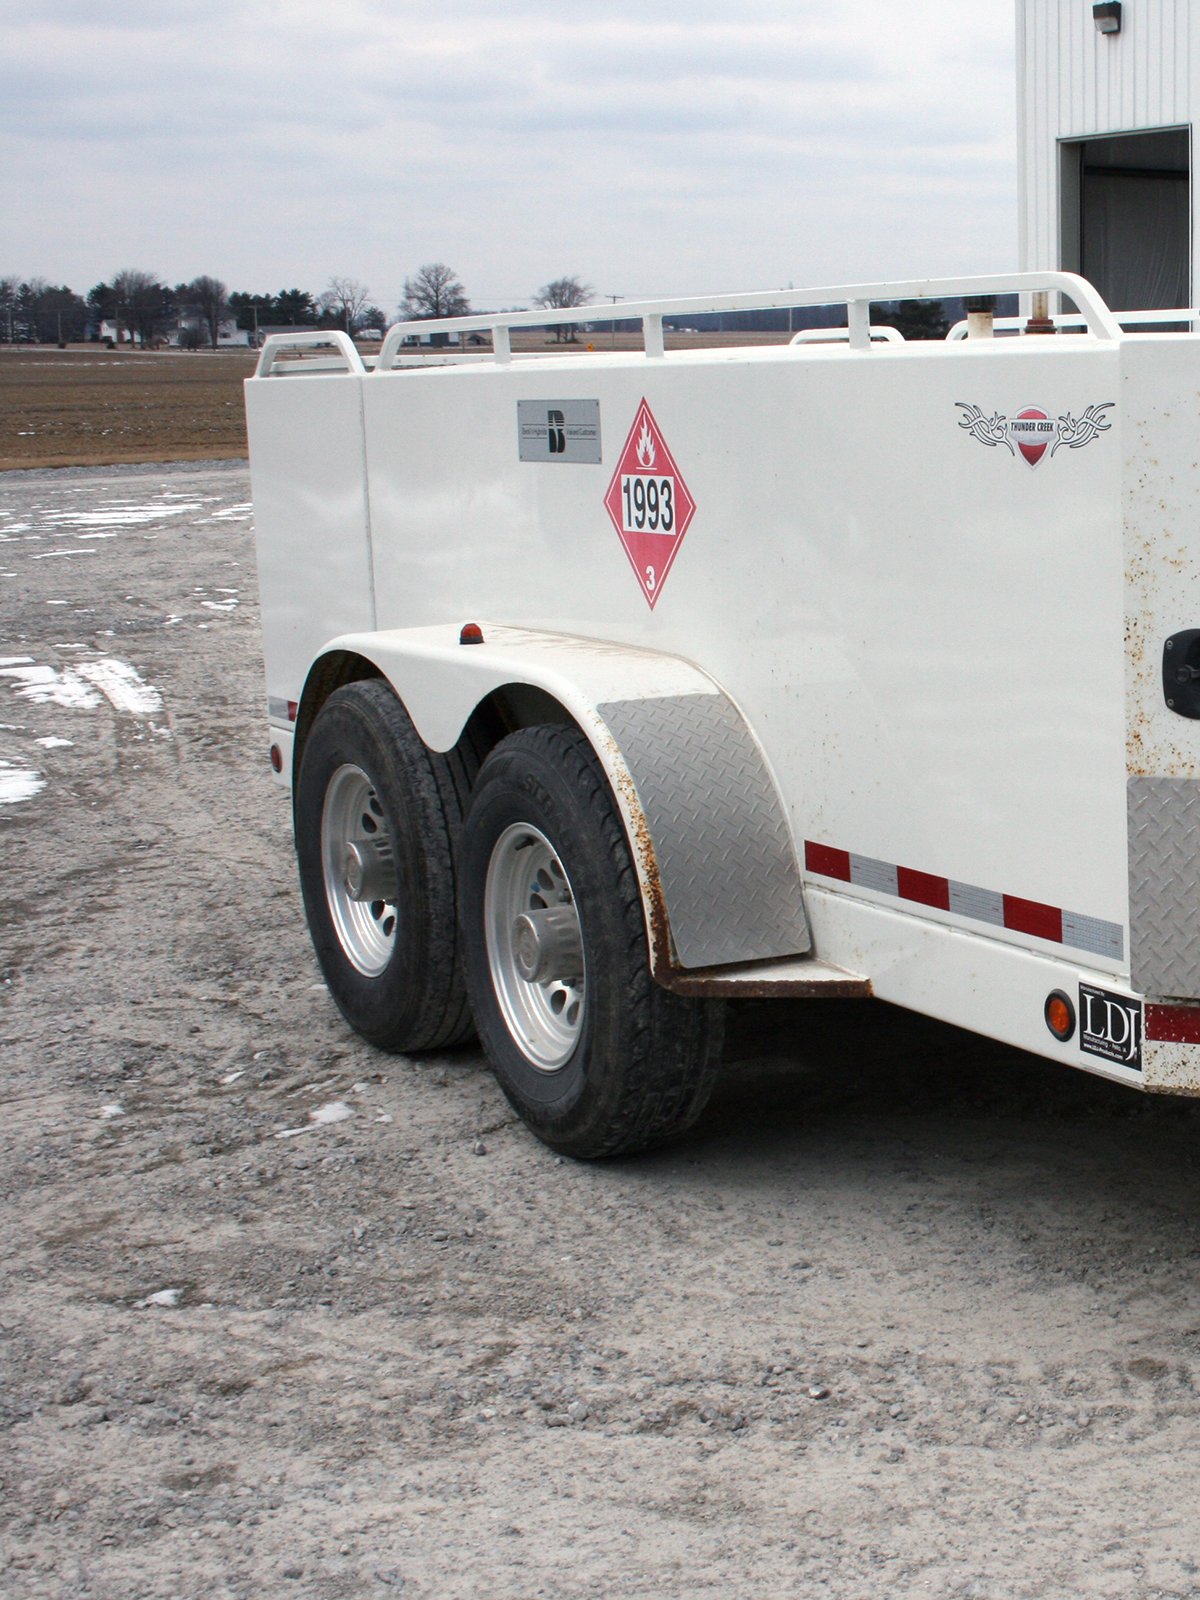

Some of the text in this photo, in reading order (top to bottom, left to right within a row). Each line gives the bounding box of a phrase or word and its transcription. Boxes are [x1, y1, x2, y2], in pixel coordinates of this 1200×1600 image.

[1010, 422, 1055, 432] THUNDER CREEK
[623, 477, 674, 532] 1993
[645, 565, 656, 591] 3
[1082, 993, 1140, 1061] LDJ
